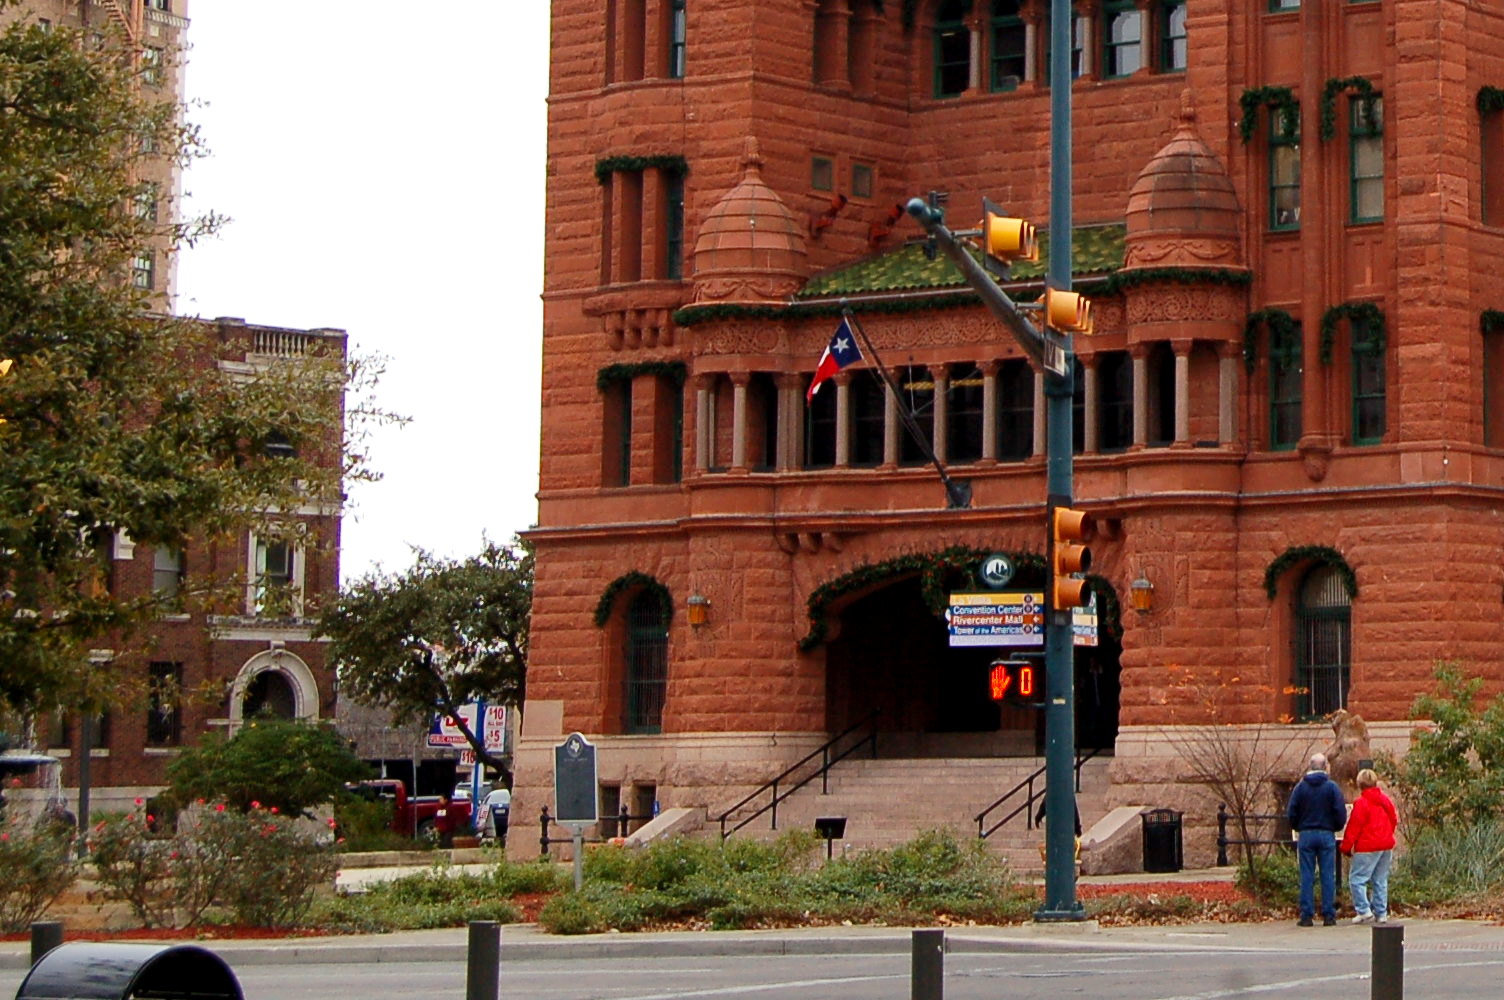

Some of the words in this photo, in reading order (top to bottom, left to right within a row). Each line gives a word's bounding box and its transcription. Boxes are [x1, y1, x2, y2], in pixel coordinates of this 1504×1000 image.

[953, 606, 996, 615] Convention
[997, 605, 1023, 614] Center
[953, 616, 1003, 625] Rivercenter
[1005, 615, 1023, 624] Mall
[489, 707, 504, 720] $10
